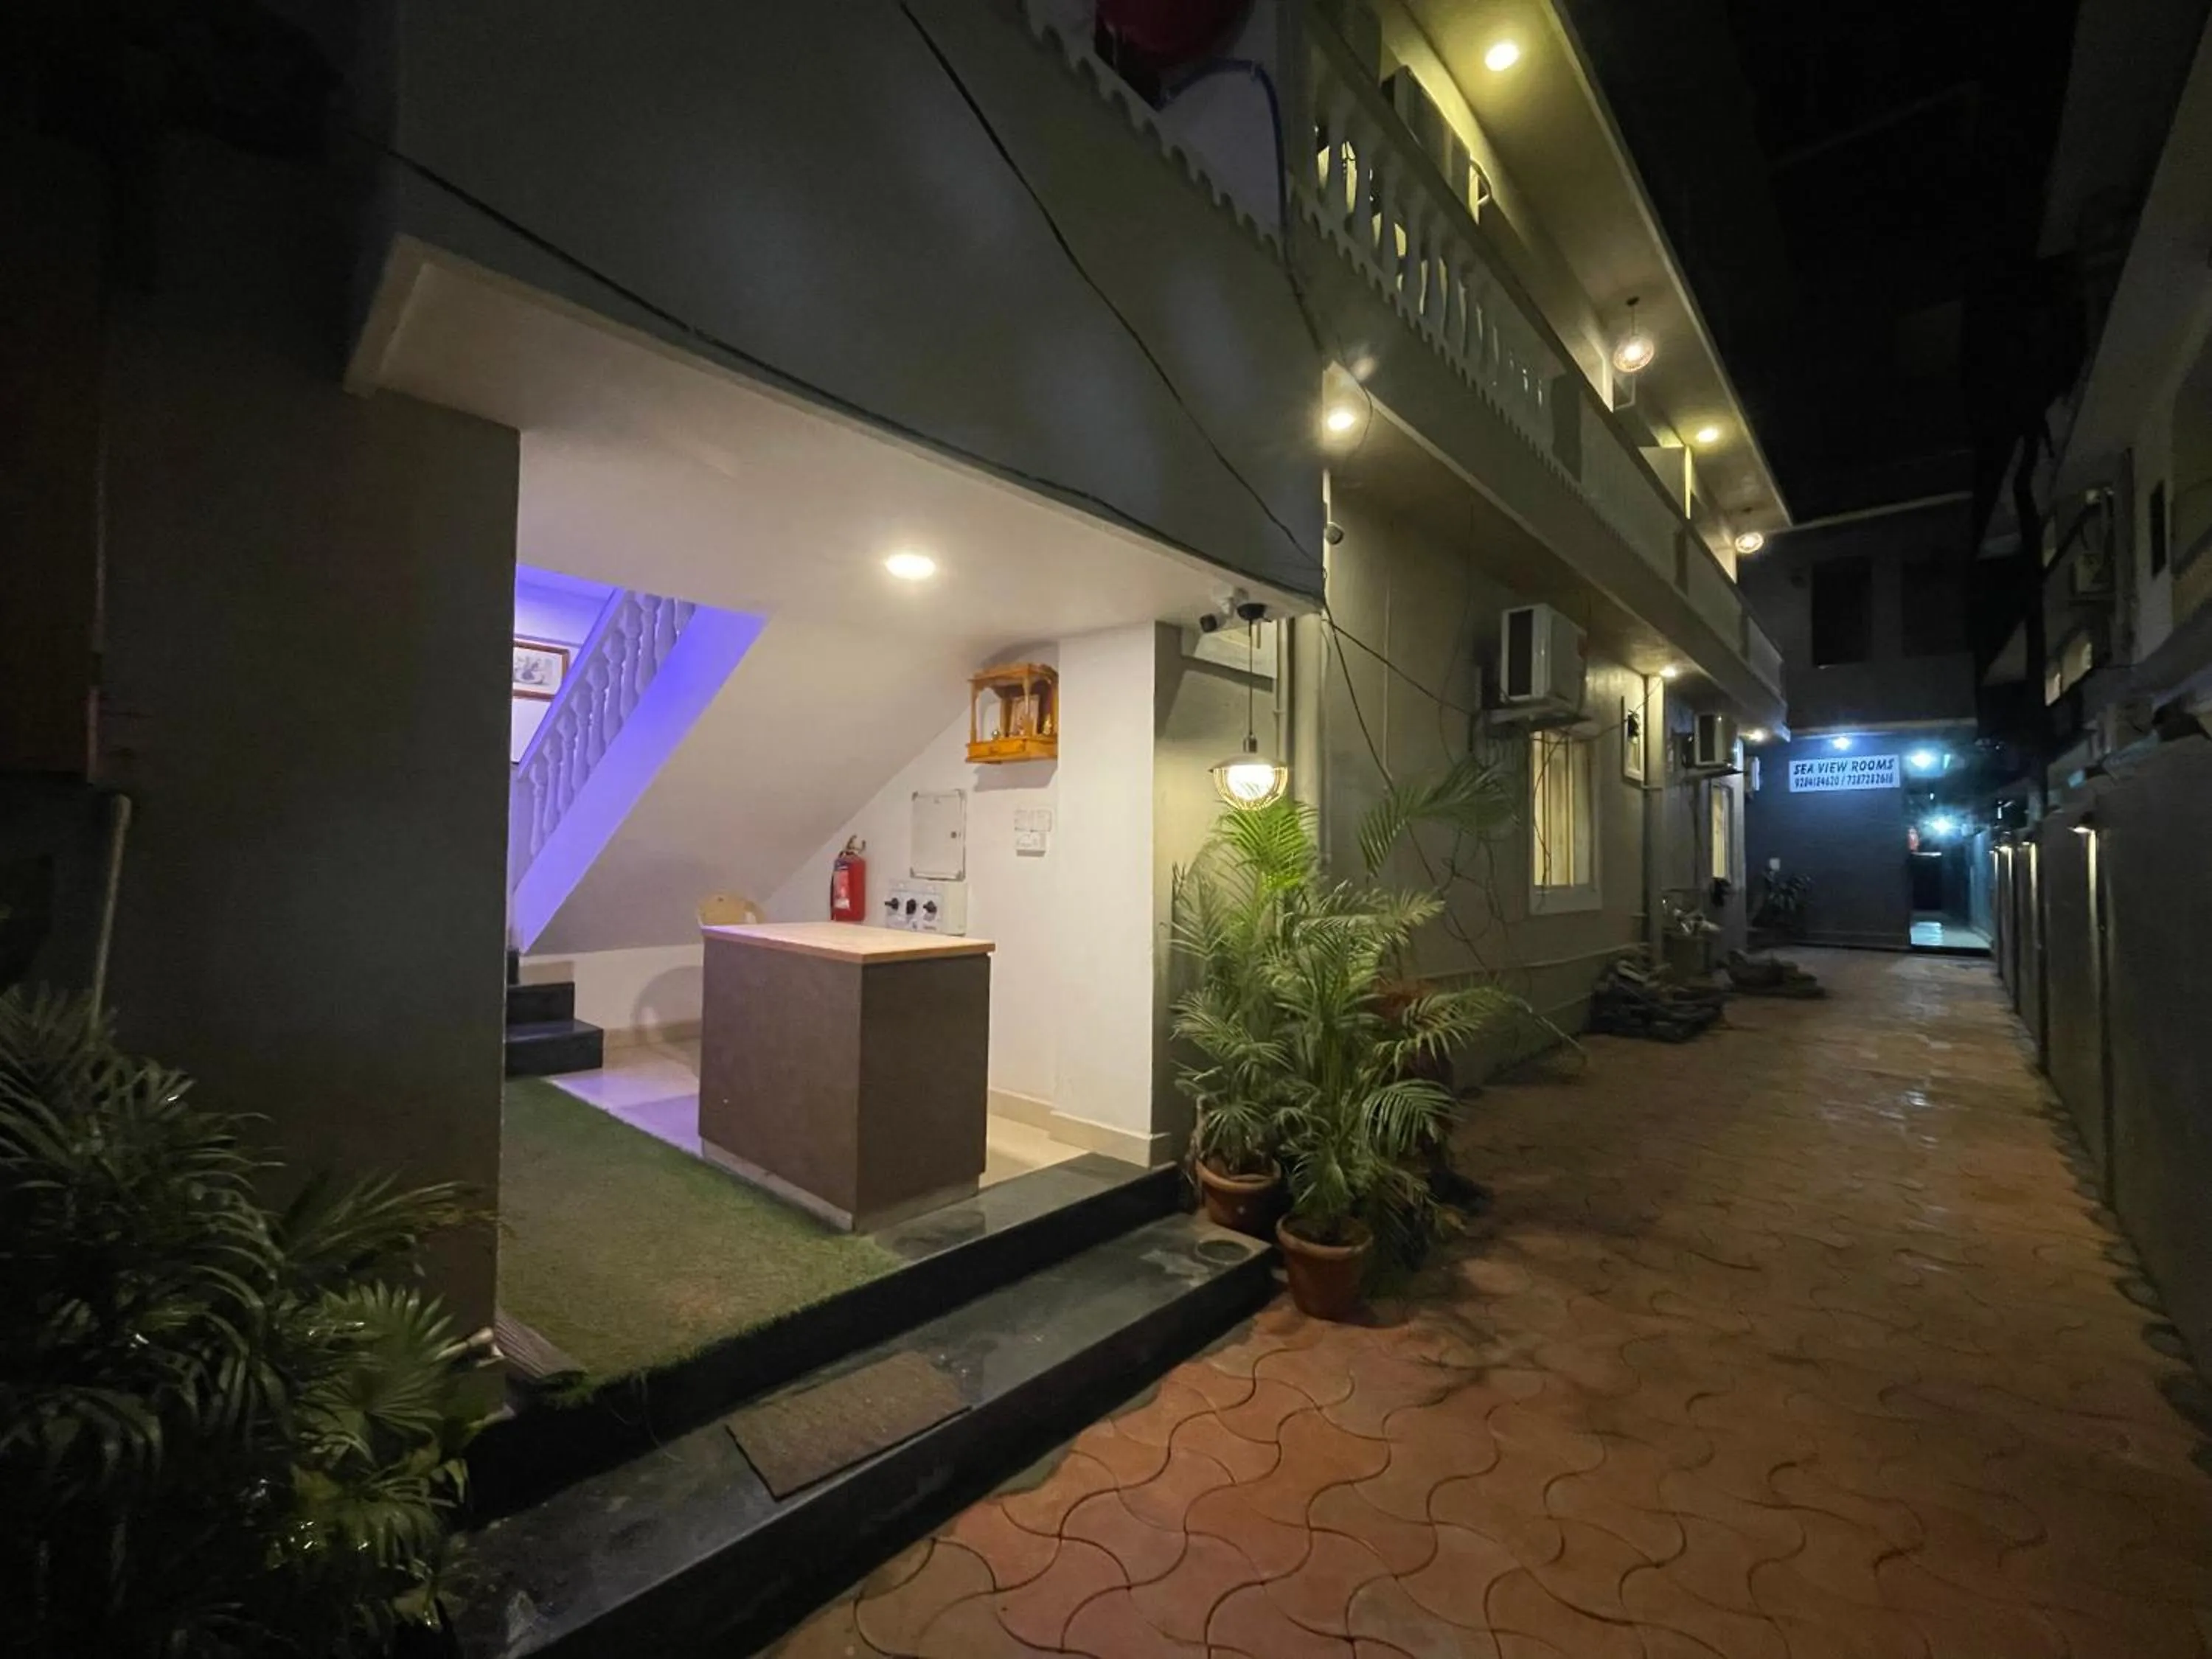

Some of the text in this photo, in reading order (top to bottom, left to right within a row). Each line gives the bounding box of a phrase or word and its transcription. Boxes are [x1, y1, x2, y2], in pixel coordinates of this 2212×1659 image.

[1794, 758, 1894, 775] SEA VIEW ROOMS
